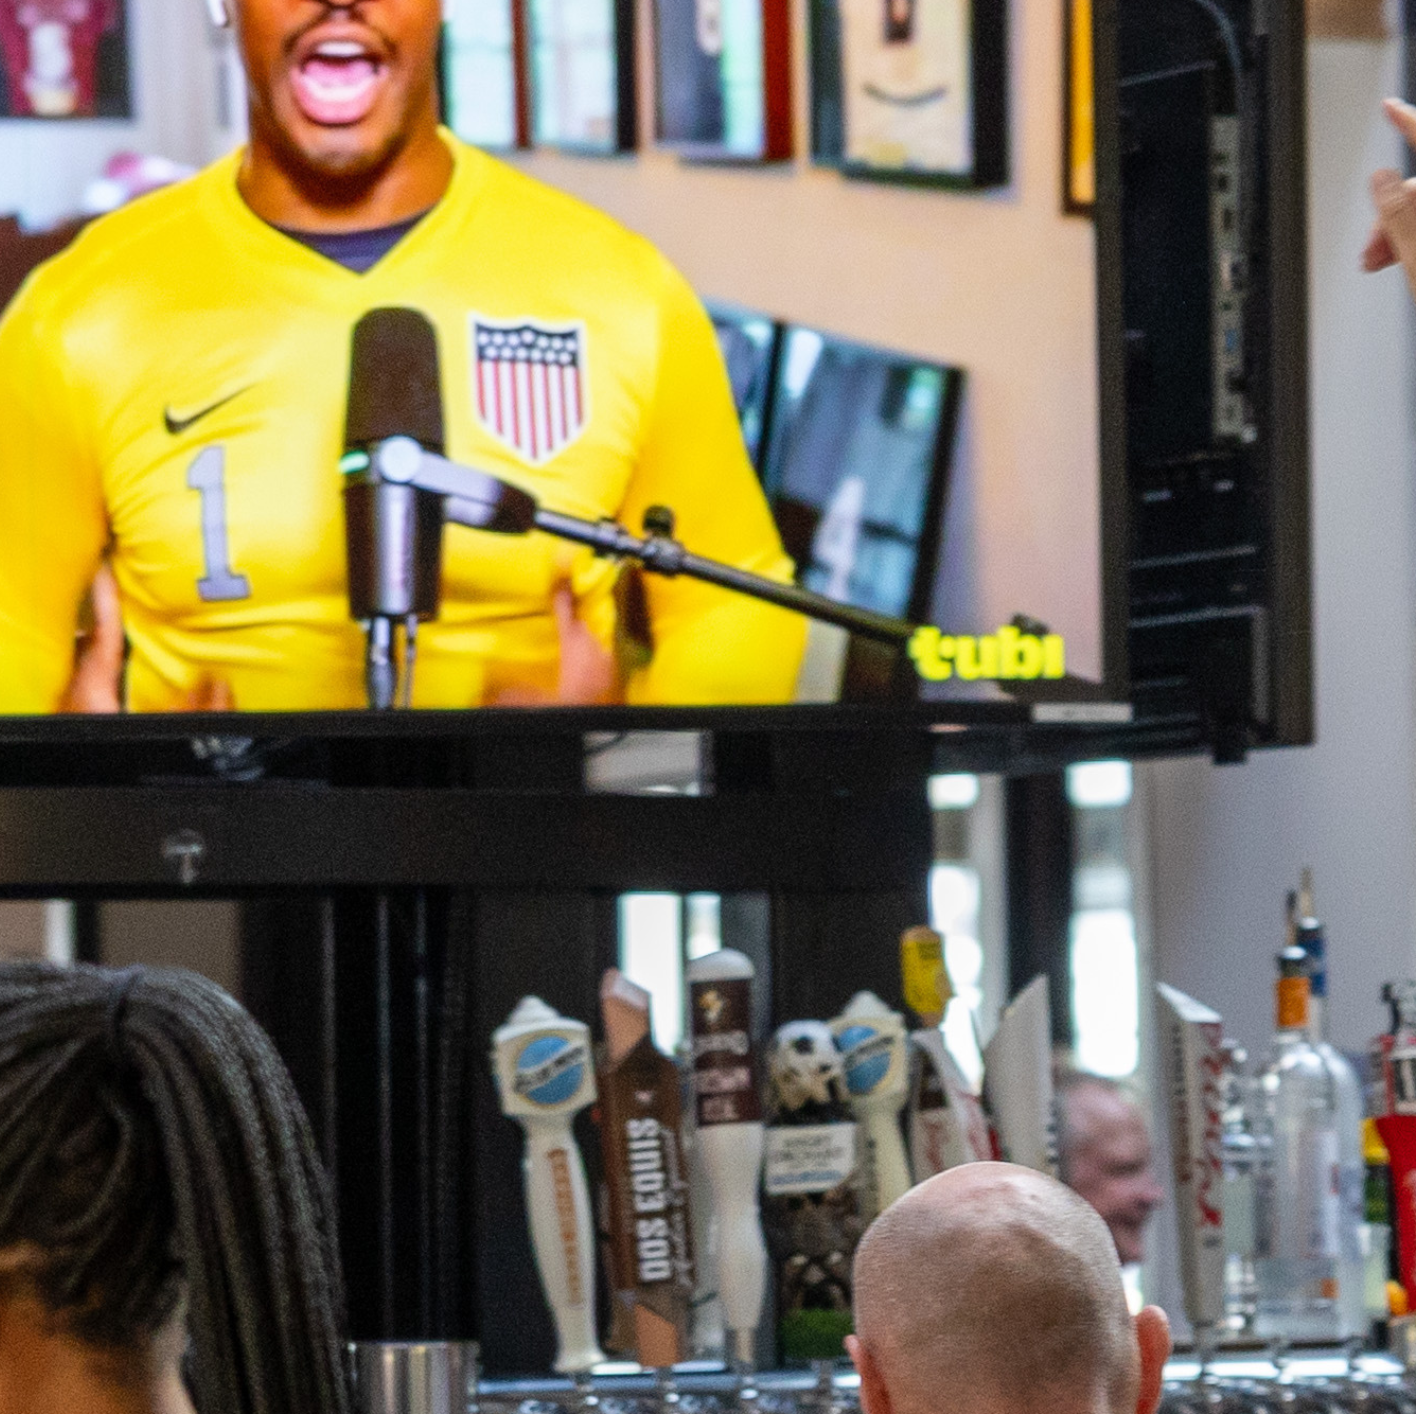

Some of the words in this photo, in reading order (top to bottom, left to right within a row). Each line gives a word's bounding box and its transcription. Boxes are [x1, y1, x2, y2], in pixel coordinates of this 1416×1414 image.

[187, 445, 251, 601] 1
[908, 624, 1066, 681] tubi
[624, 1117, 666, 1214] EQUIS
[635, 1216, 673, 1283] DOS
